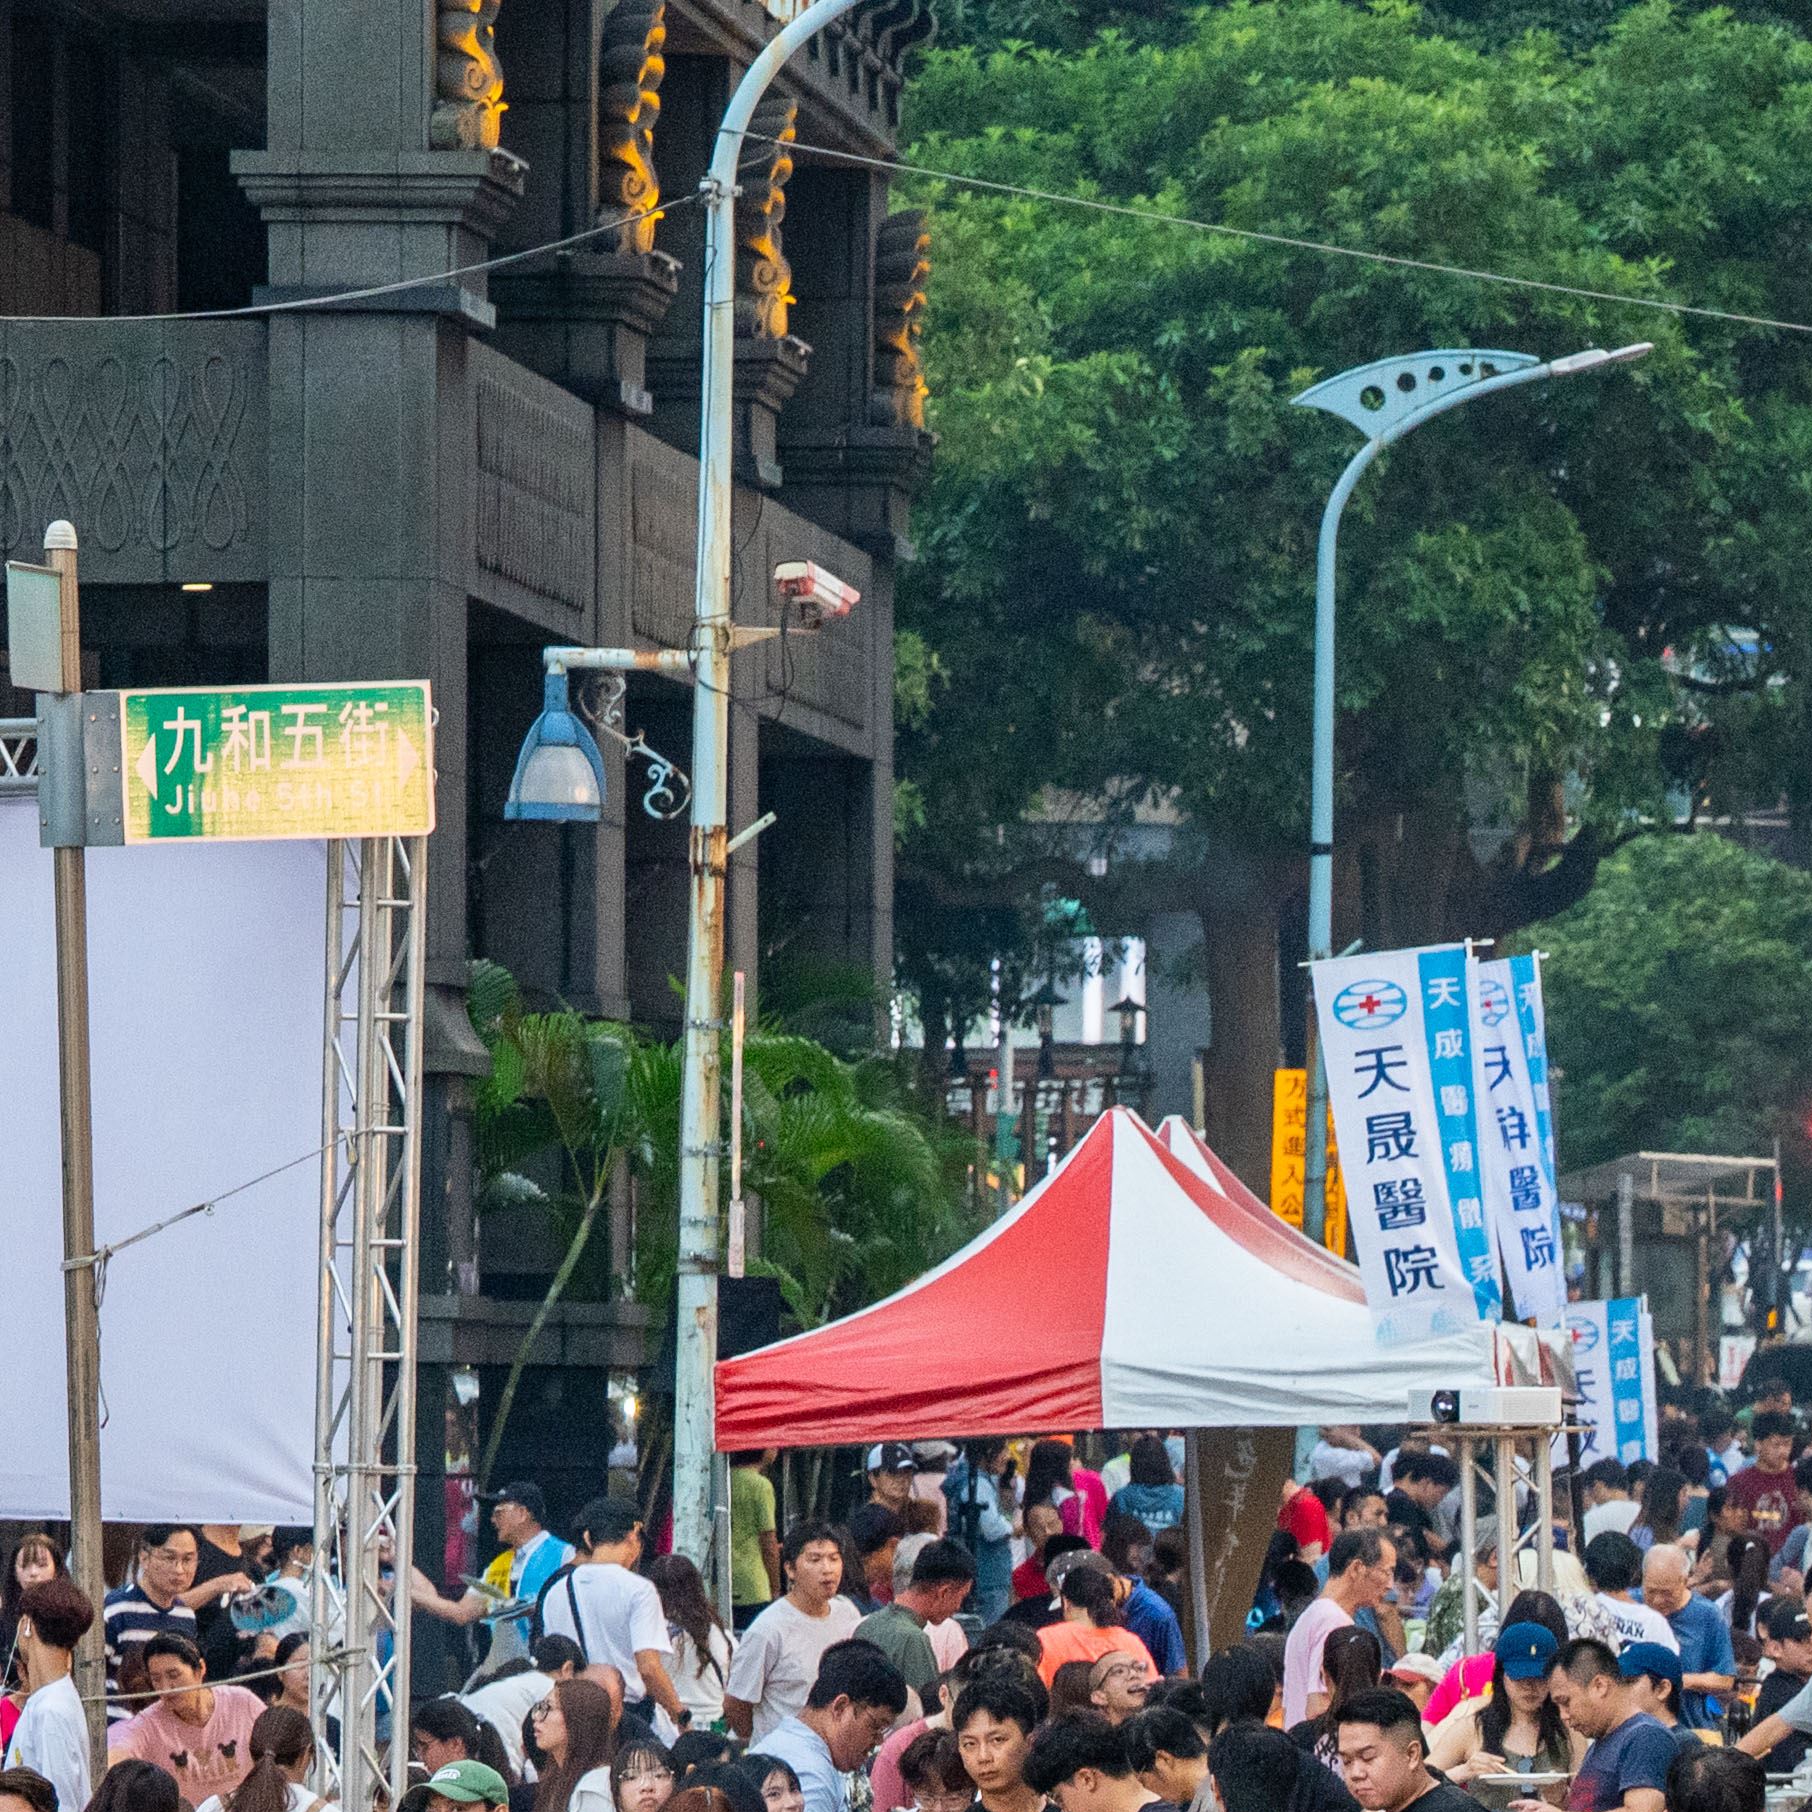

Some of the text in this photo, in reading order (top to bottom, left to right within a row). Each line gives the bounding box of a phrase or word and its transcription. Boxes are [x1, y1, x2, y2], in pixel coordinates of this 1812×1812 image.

[163, 701, 389, 775] 九和五街
[164, 782, 262, 816] Jiuhe
[1353, 1045, 1446, 1297] 天晟醫院
